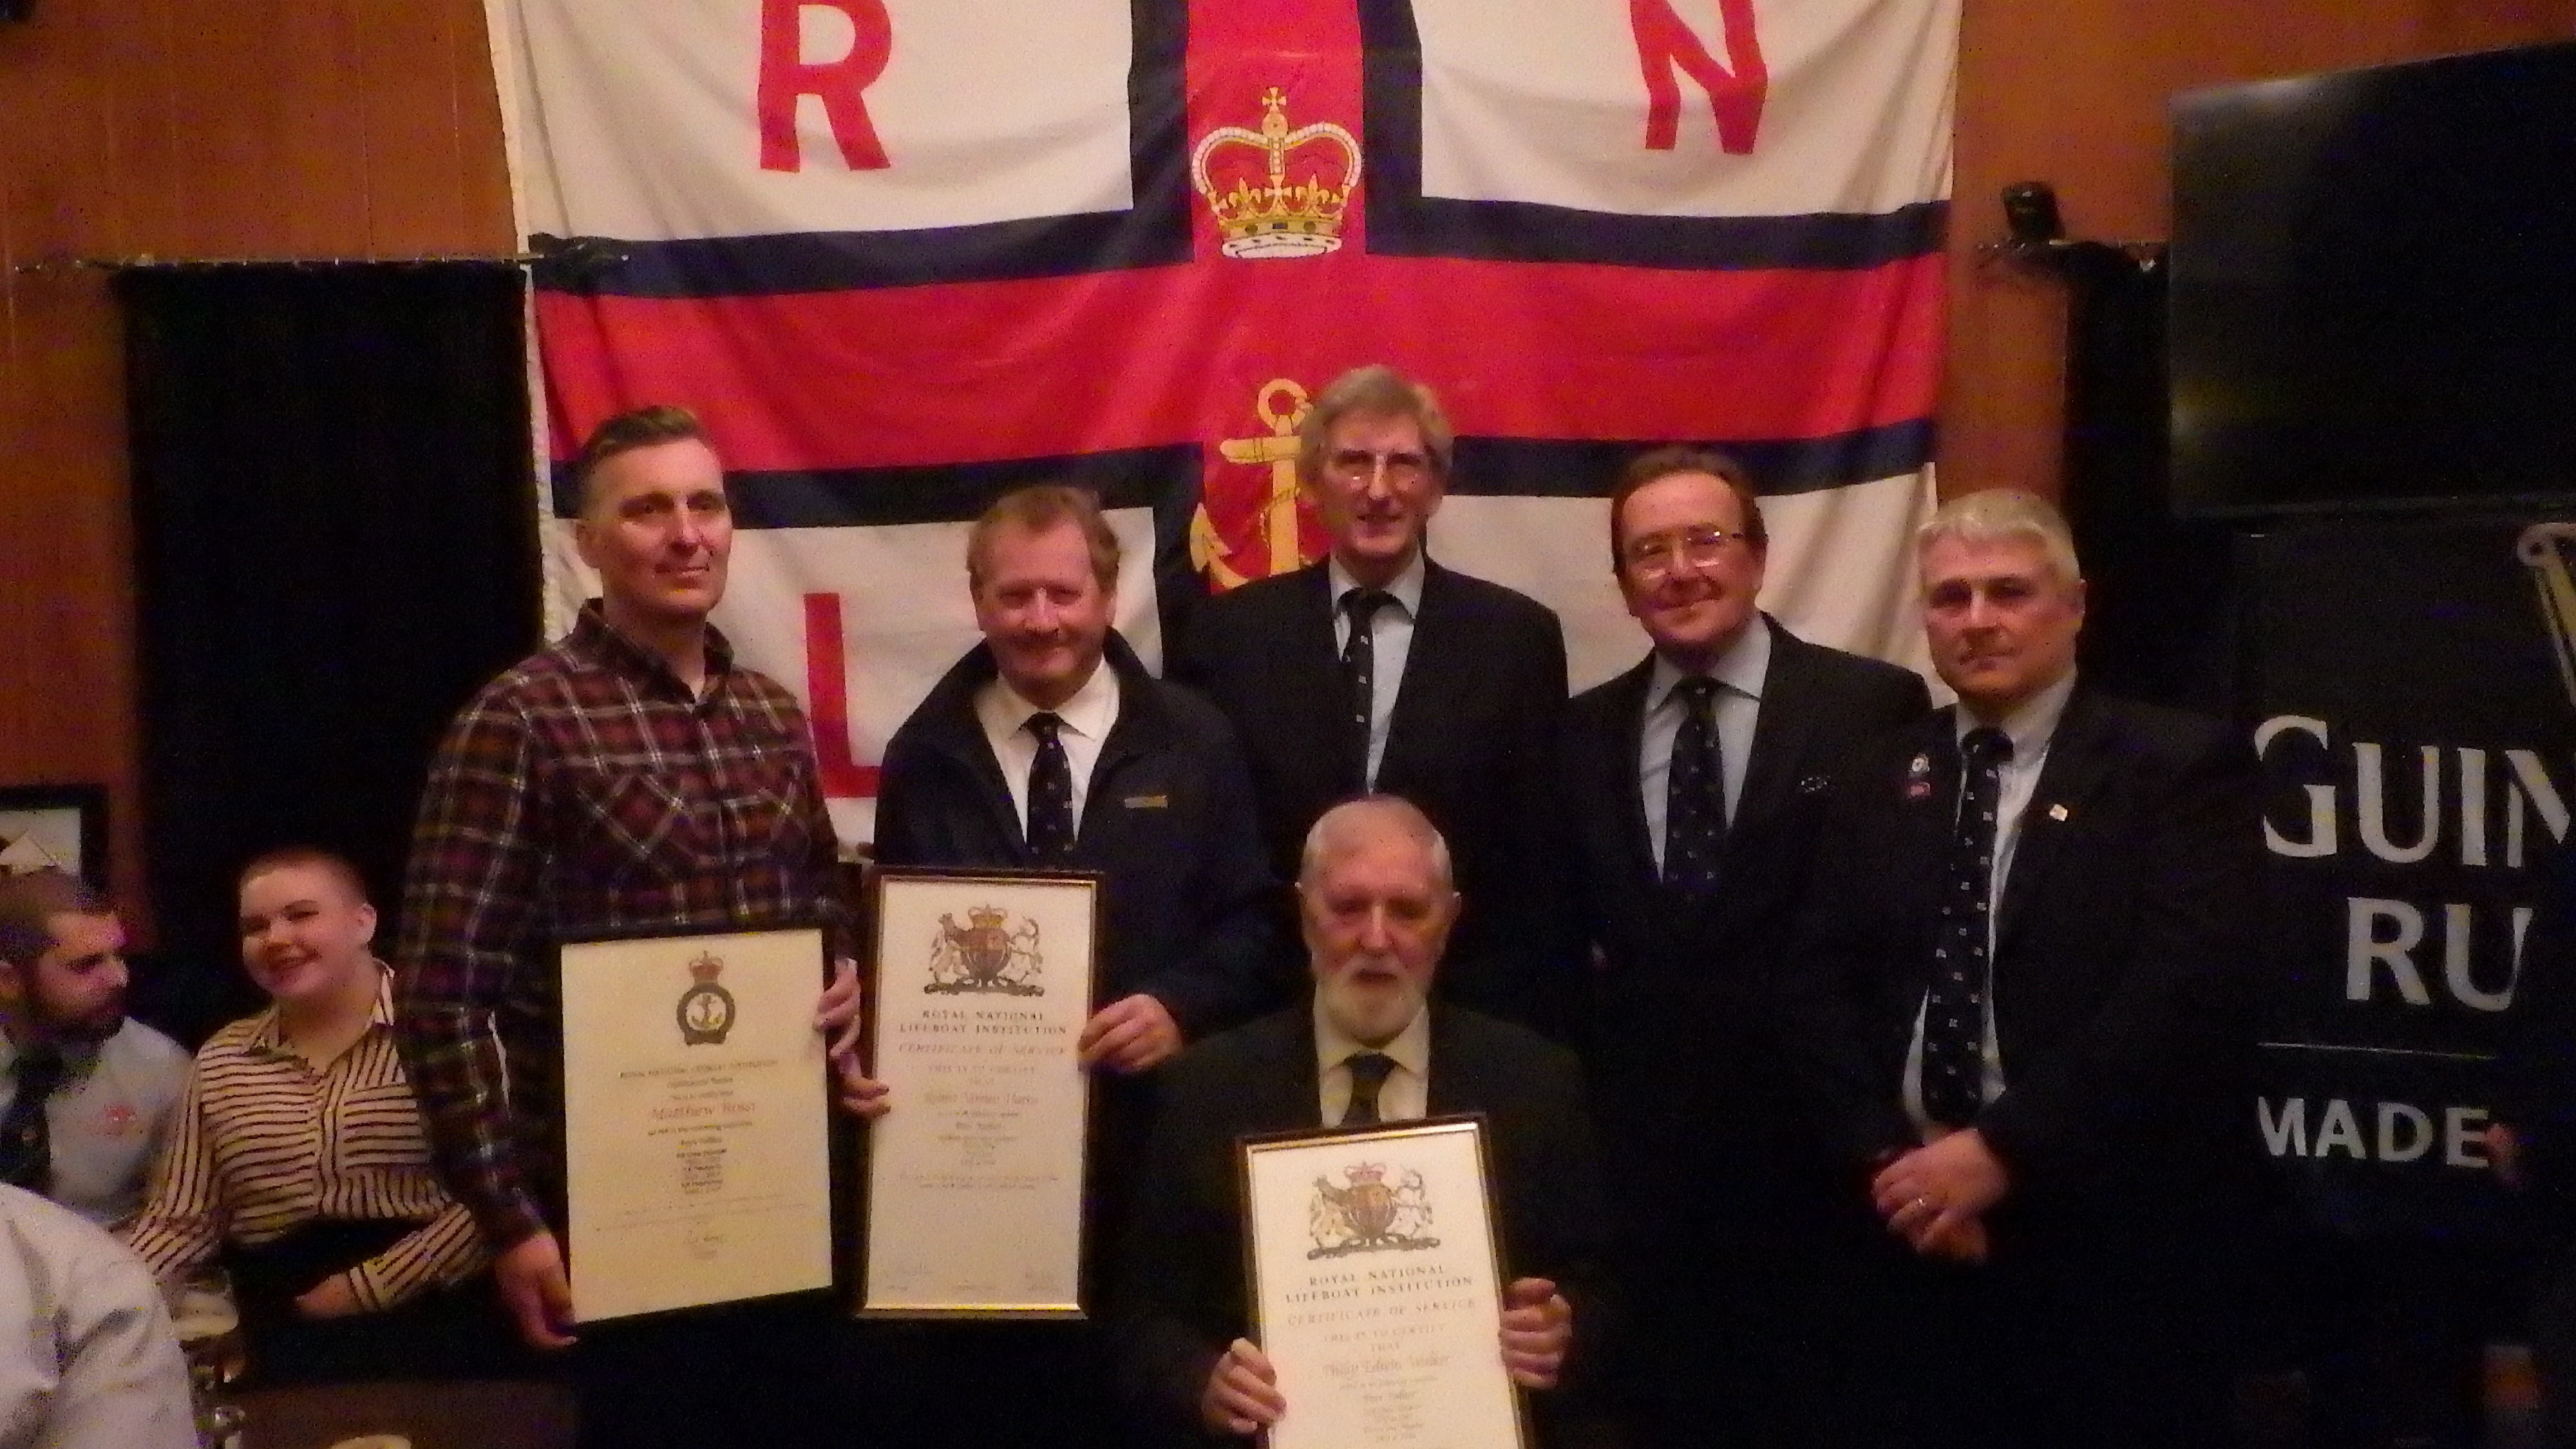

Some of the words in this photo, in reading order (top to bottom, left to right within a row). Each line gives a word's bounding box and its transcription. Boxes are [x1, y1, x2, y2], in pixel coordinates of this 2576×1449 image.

[759, 0, 893, 173] R
[1629, 0, 1768, 155] N
[803, 593, 882, 798] L
[922, 1010, 966, 1020] ROYAL
[976, 1011, 1044, 1021] NATIONAL
[899, 1024, 967, 1033] LIFEBOAT
[976, 1025, 1067, 1035] INSTITUTION
[2256, 1096, 2490, 1168] MADE
[1309, 1273, 1357, 1287] ROYAL
[1368, 1265, 1445, 1280] NATIONAL
[1286, 1287, 1361, 1303] LIFEBOAT
[1371, 1277, 1473, 1296] INSTITUTION
[1287, 1308, 1381, 1327] CERTIFICATE
